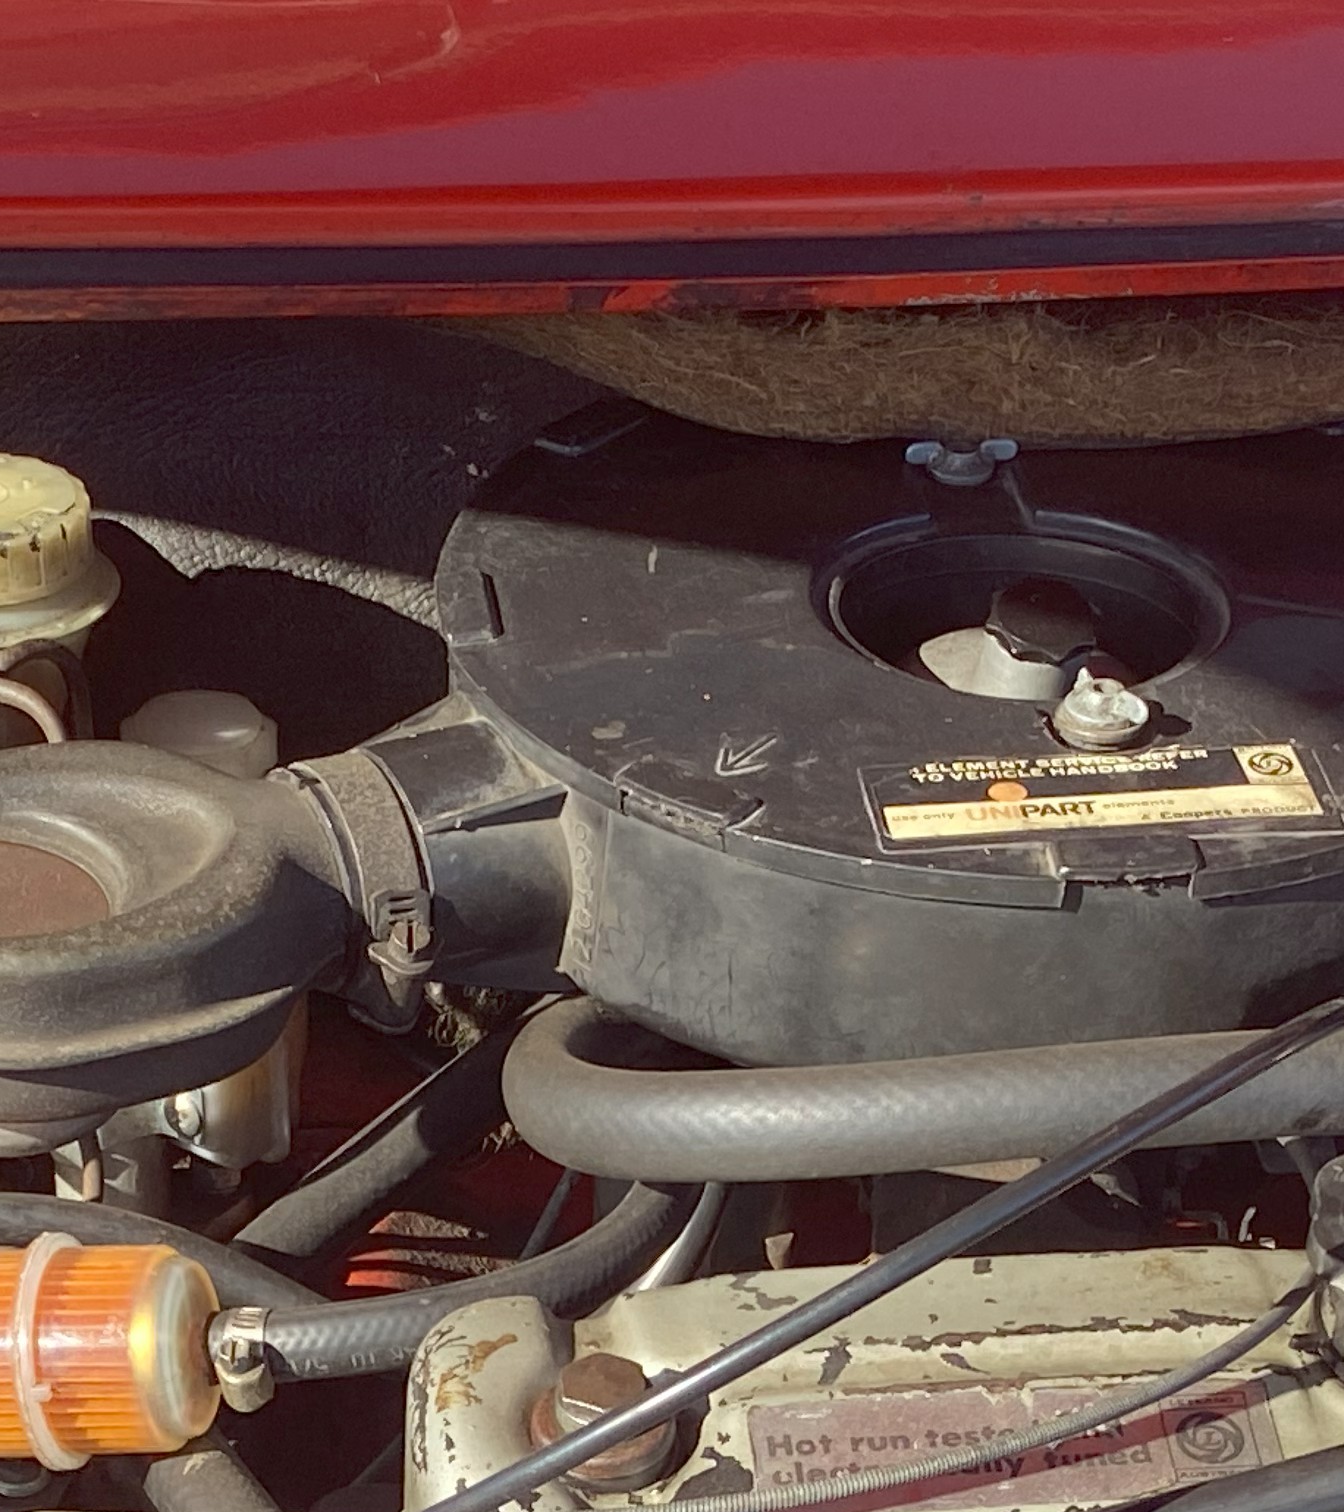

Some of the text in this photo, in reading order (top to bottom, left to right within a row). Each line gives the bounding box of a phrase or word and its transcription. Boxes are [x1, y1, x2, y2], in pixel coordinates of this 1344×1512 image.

[911, 760, 1180, 785] TO VEHICLE HANDBOOK
[924, 758, 1030, 774] ELEMENT
[1035, 754, 1131, 770] SERVICE
[891, 798, 1176, 823] use only UNIPART elements
[1240, 804, 1316, 815] PRODUCT
[766, 1434, 833, 1457] Hot
[850, 1434, 910, 1452] run
[1043, 1443, 1152, 1469] tuned
